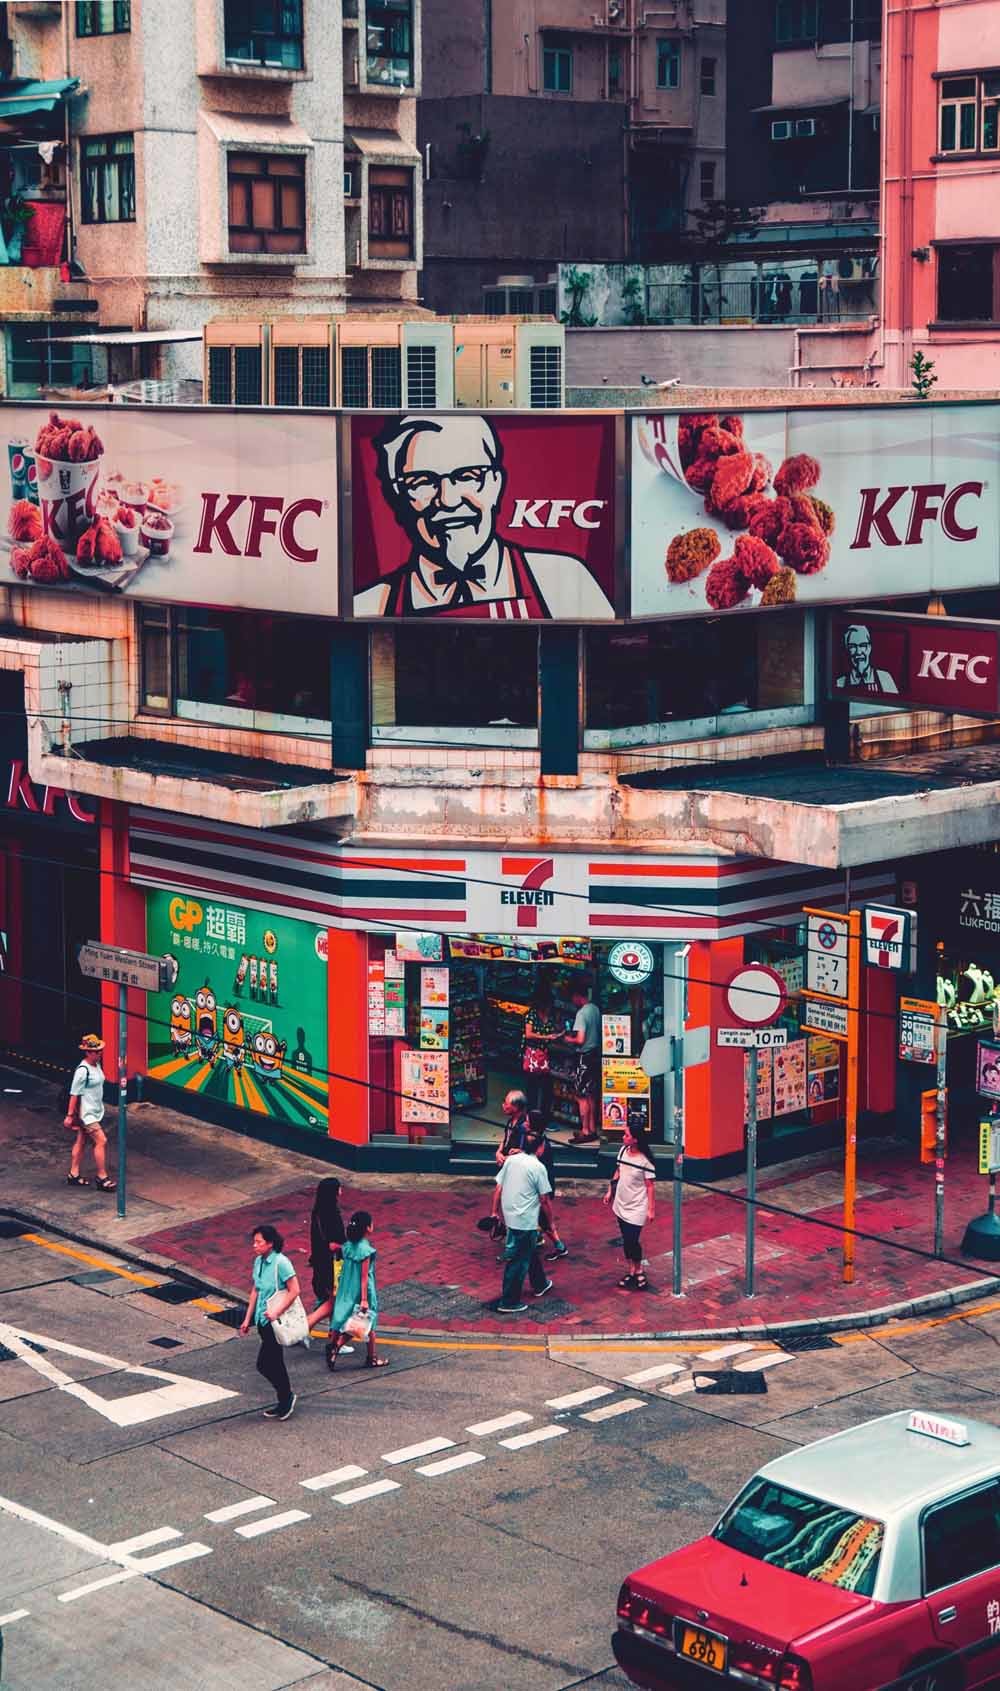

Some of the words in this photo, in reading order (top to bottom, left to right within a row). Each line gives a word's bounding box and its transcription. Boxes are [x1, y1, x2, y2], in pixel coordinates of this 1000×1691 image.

[193, 493, 323, 562] KFC
[508, 500, 604, 528] KFC
[849, 481, 983, 549] KFC
[917, 650, 990, 684] KFC
[169, 897, 203, 932] GP
[206, 905, 246, 945] 超霸
[832, 959, 839, 971] 7
[832, 979, 839, 991] 7
[755, 1033, 771, 1045] 10
[773, 1035, 785, 1043] m
[912, 1415, 939, 1434] TAXI
